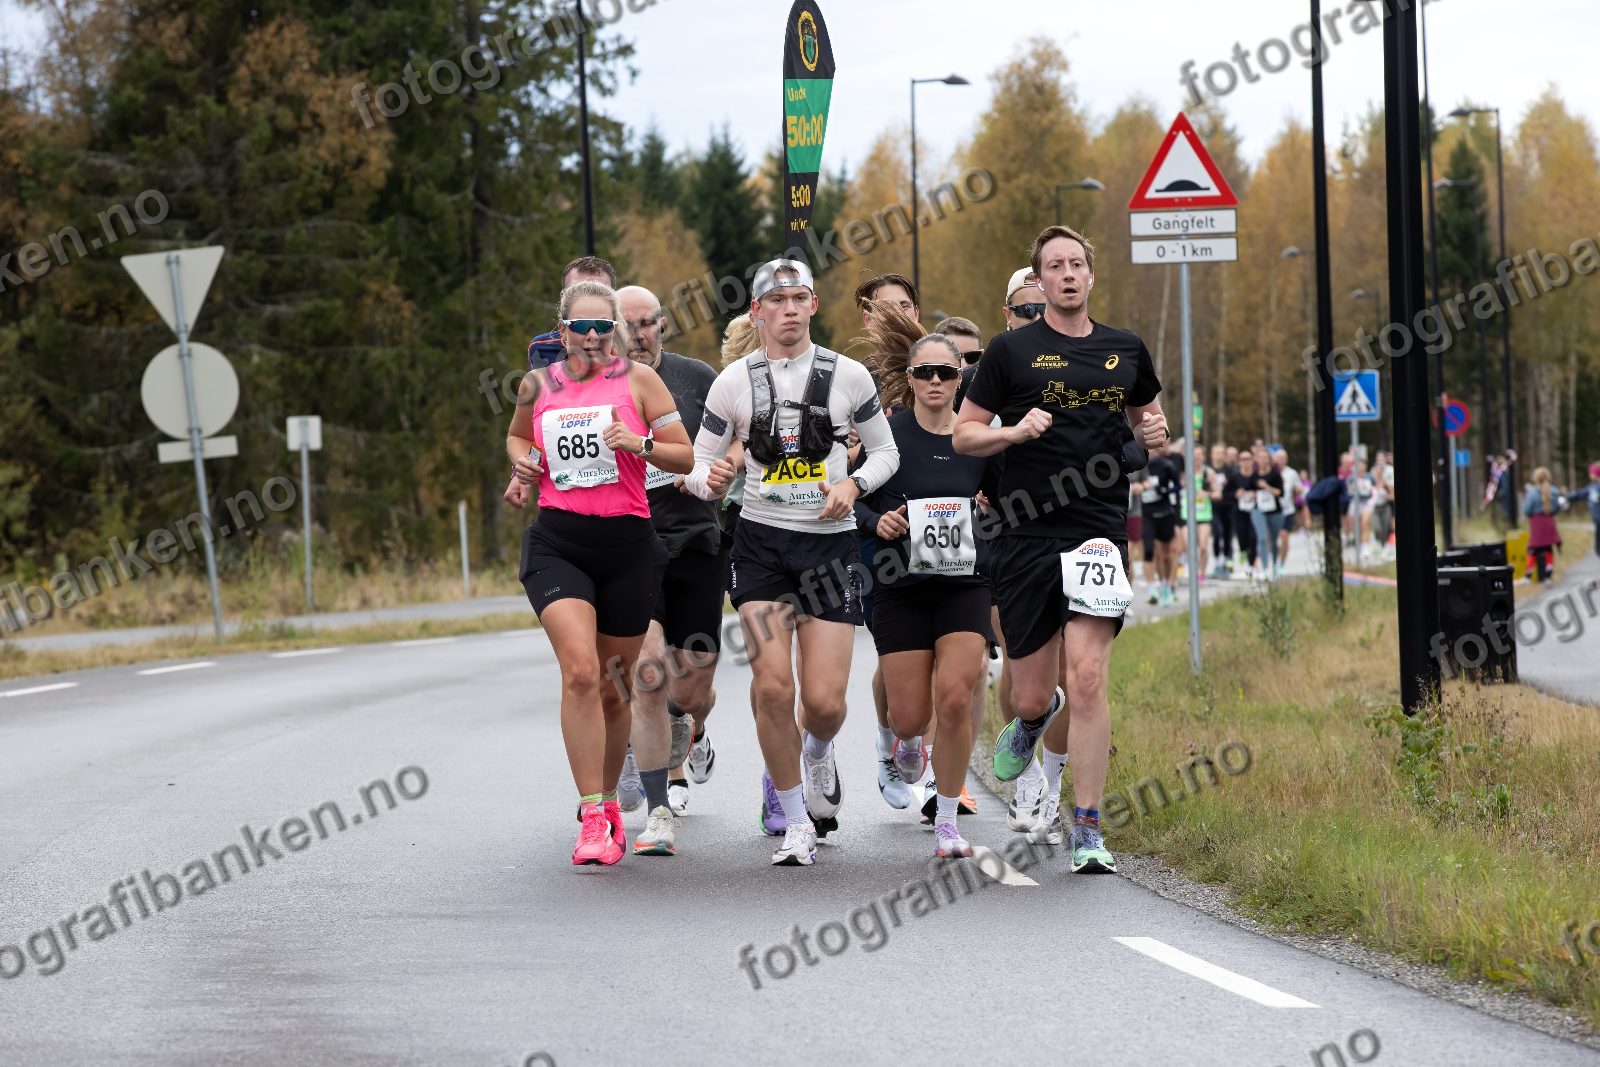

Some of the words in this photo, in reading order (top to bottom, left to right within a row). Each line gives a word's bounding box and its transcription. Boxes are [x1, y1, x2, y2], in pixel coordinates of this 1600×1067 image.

[786, 113, 824, 148] 50:00
[791, 184, 811, 208] 5:00
[1152, 216, 1215, 232] Gangfelt
[1191, 244, 1213, 257] km
[557, 411, 600, 422] NORGES
[560, 419, 593, 430] LØPET
[557, 433, 600, 461] 685
[576, 467, 616, 480] Aurskog
[923, 503, 962, 511] NORGES
[928, 510, 958, 518] LØPET
[923, 524, 961, 549] 650
[937, 559, 974, 568] Aurskog
[1075, 561, 1117, 586] 737
